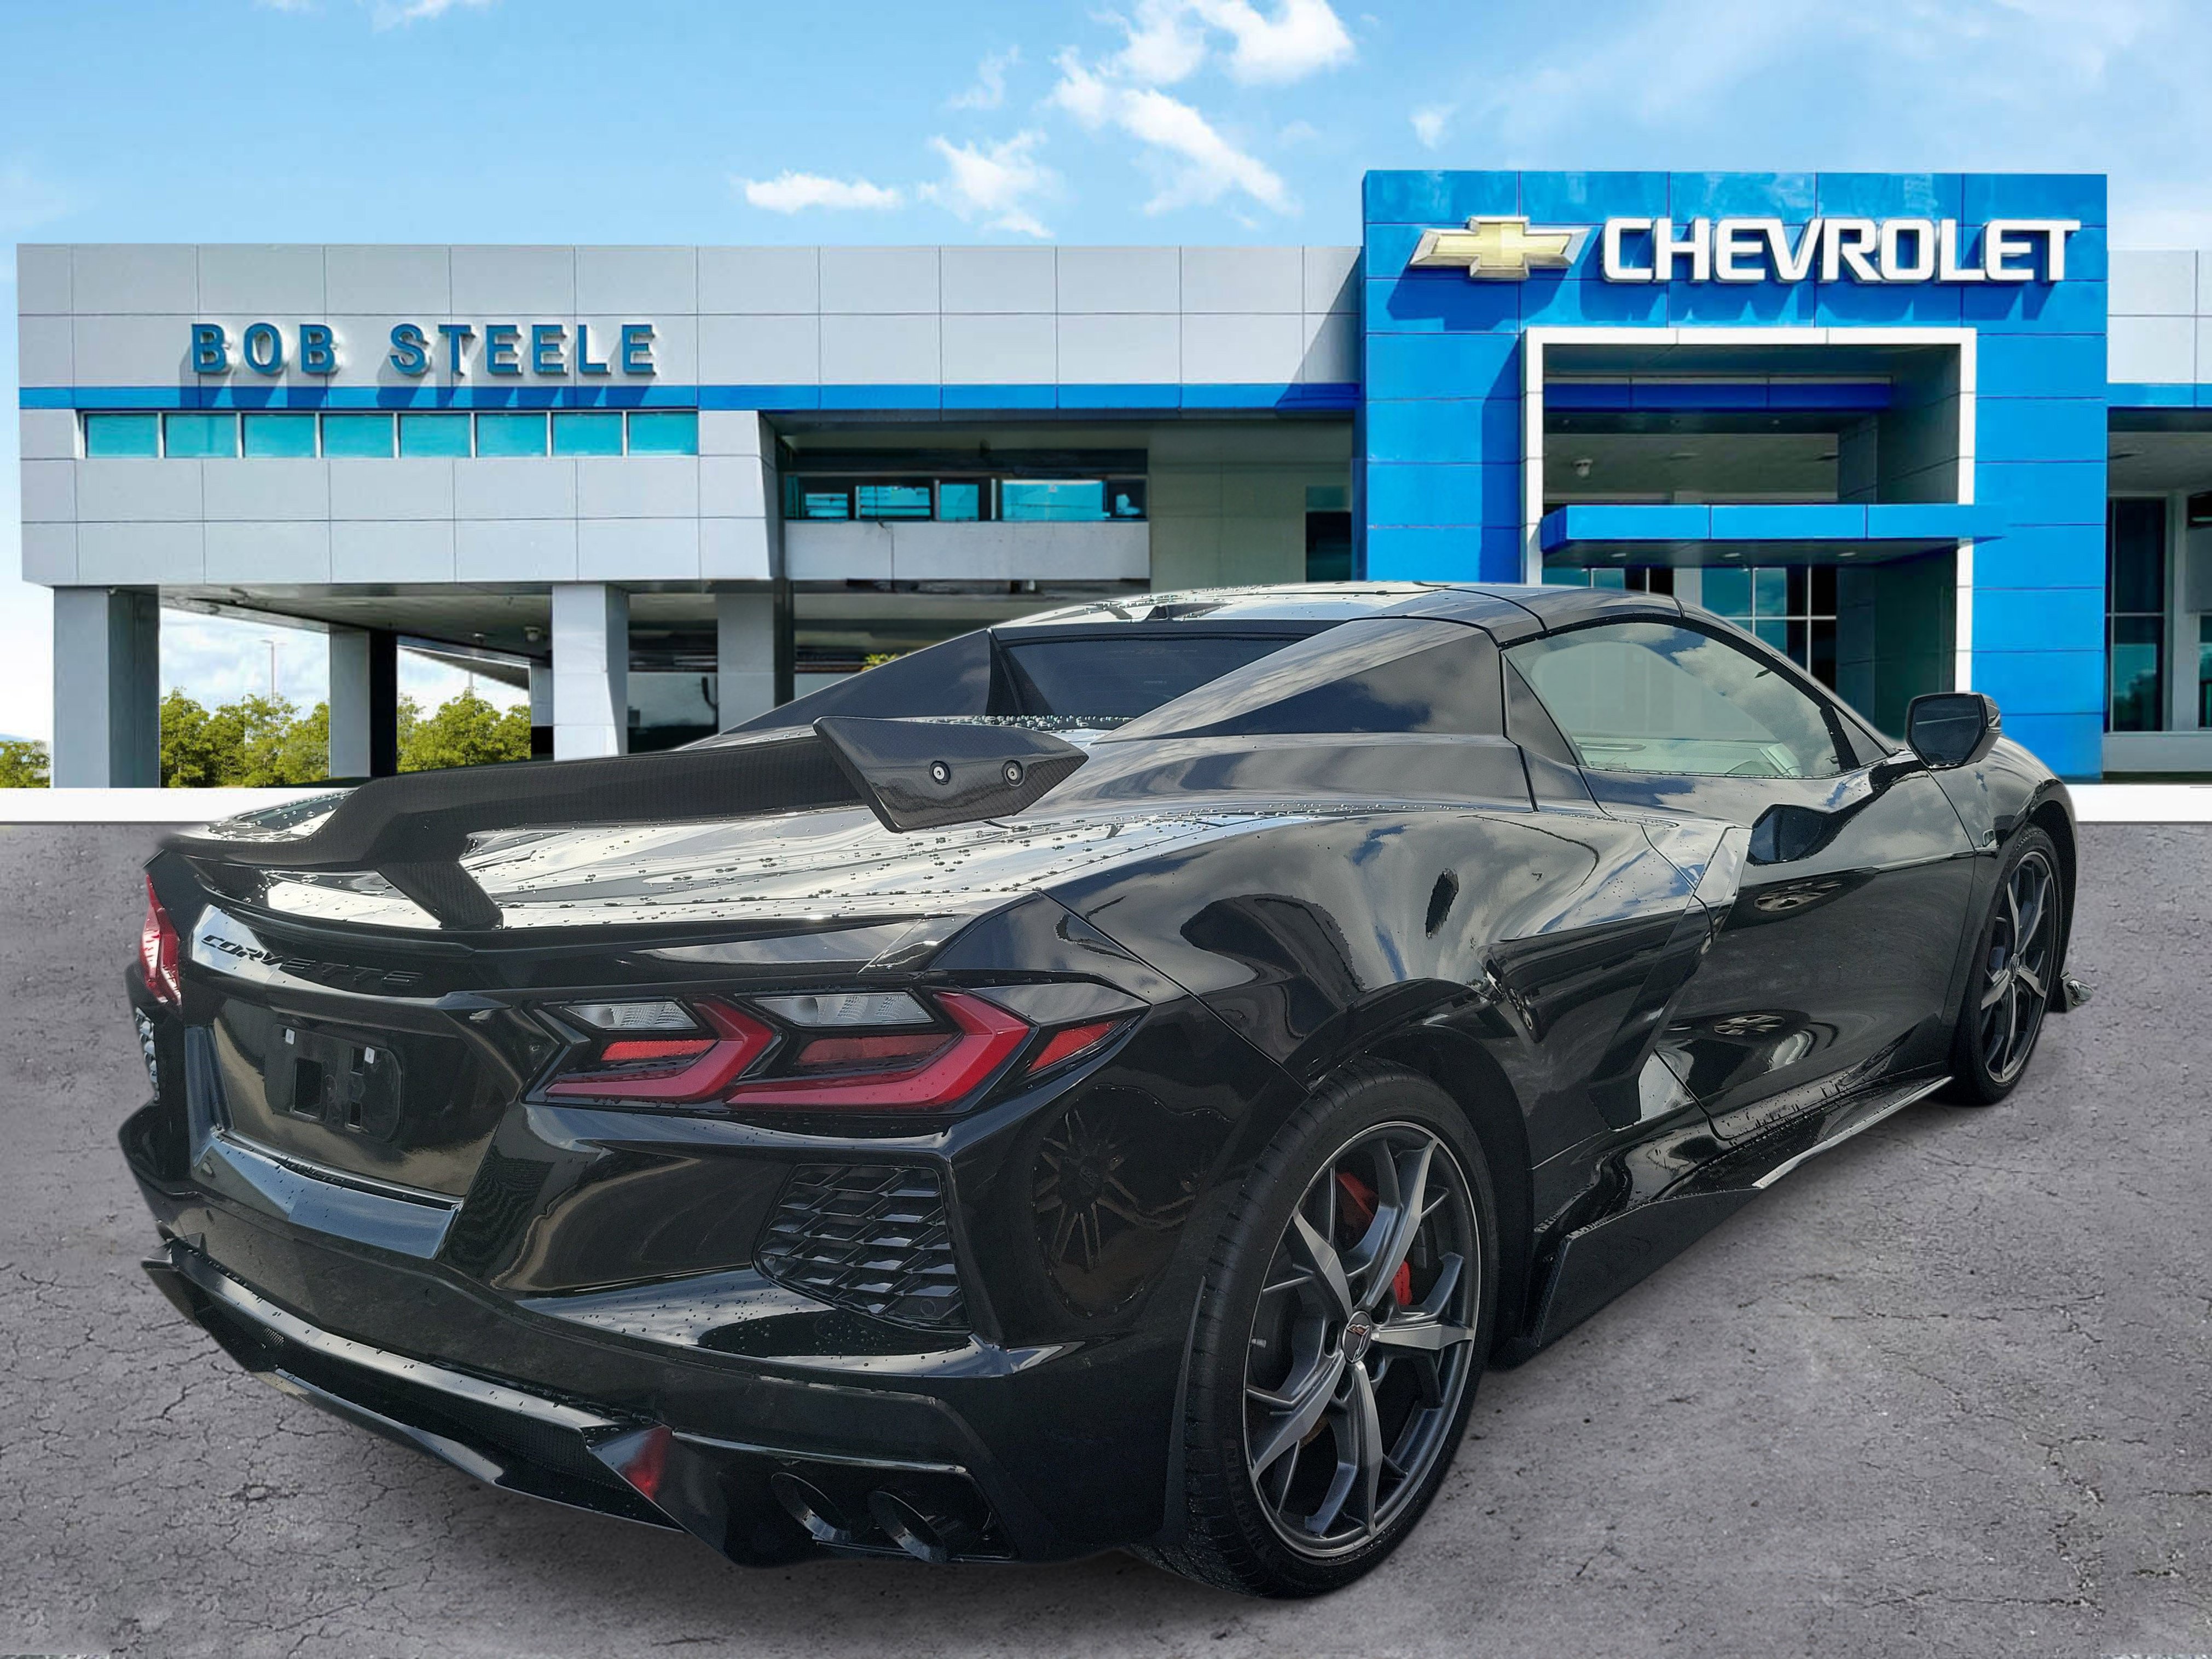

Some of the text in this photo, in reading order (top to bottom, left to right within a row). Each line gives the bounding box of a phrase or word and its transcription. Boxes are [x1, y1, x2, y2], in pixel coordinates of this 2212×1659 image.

[1603, 217, 2081, 282] CHEVROLET
[191, 322, 658, 375] BOB STEELE
[201, 934, 423, 986] CORVETTE
